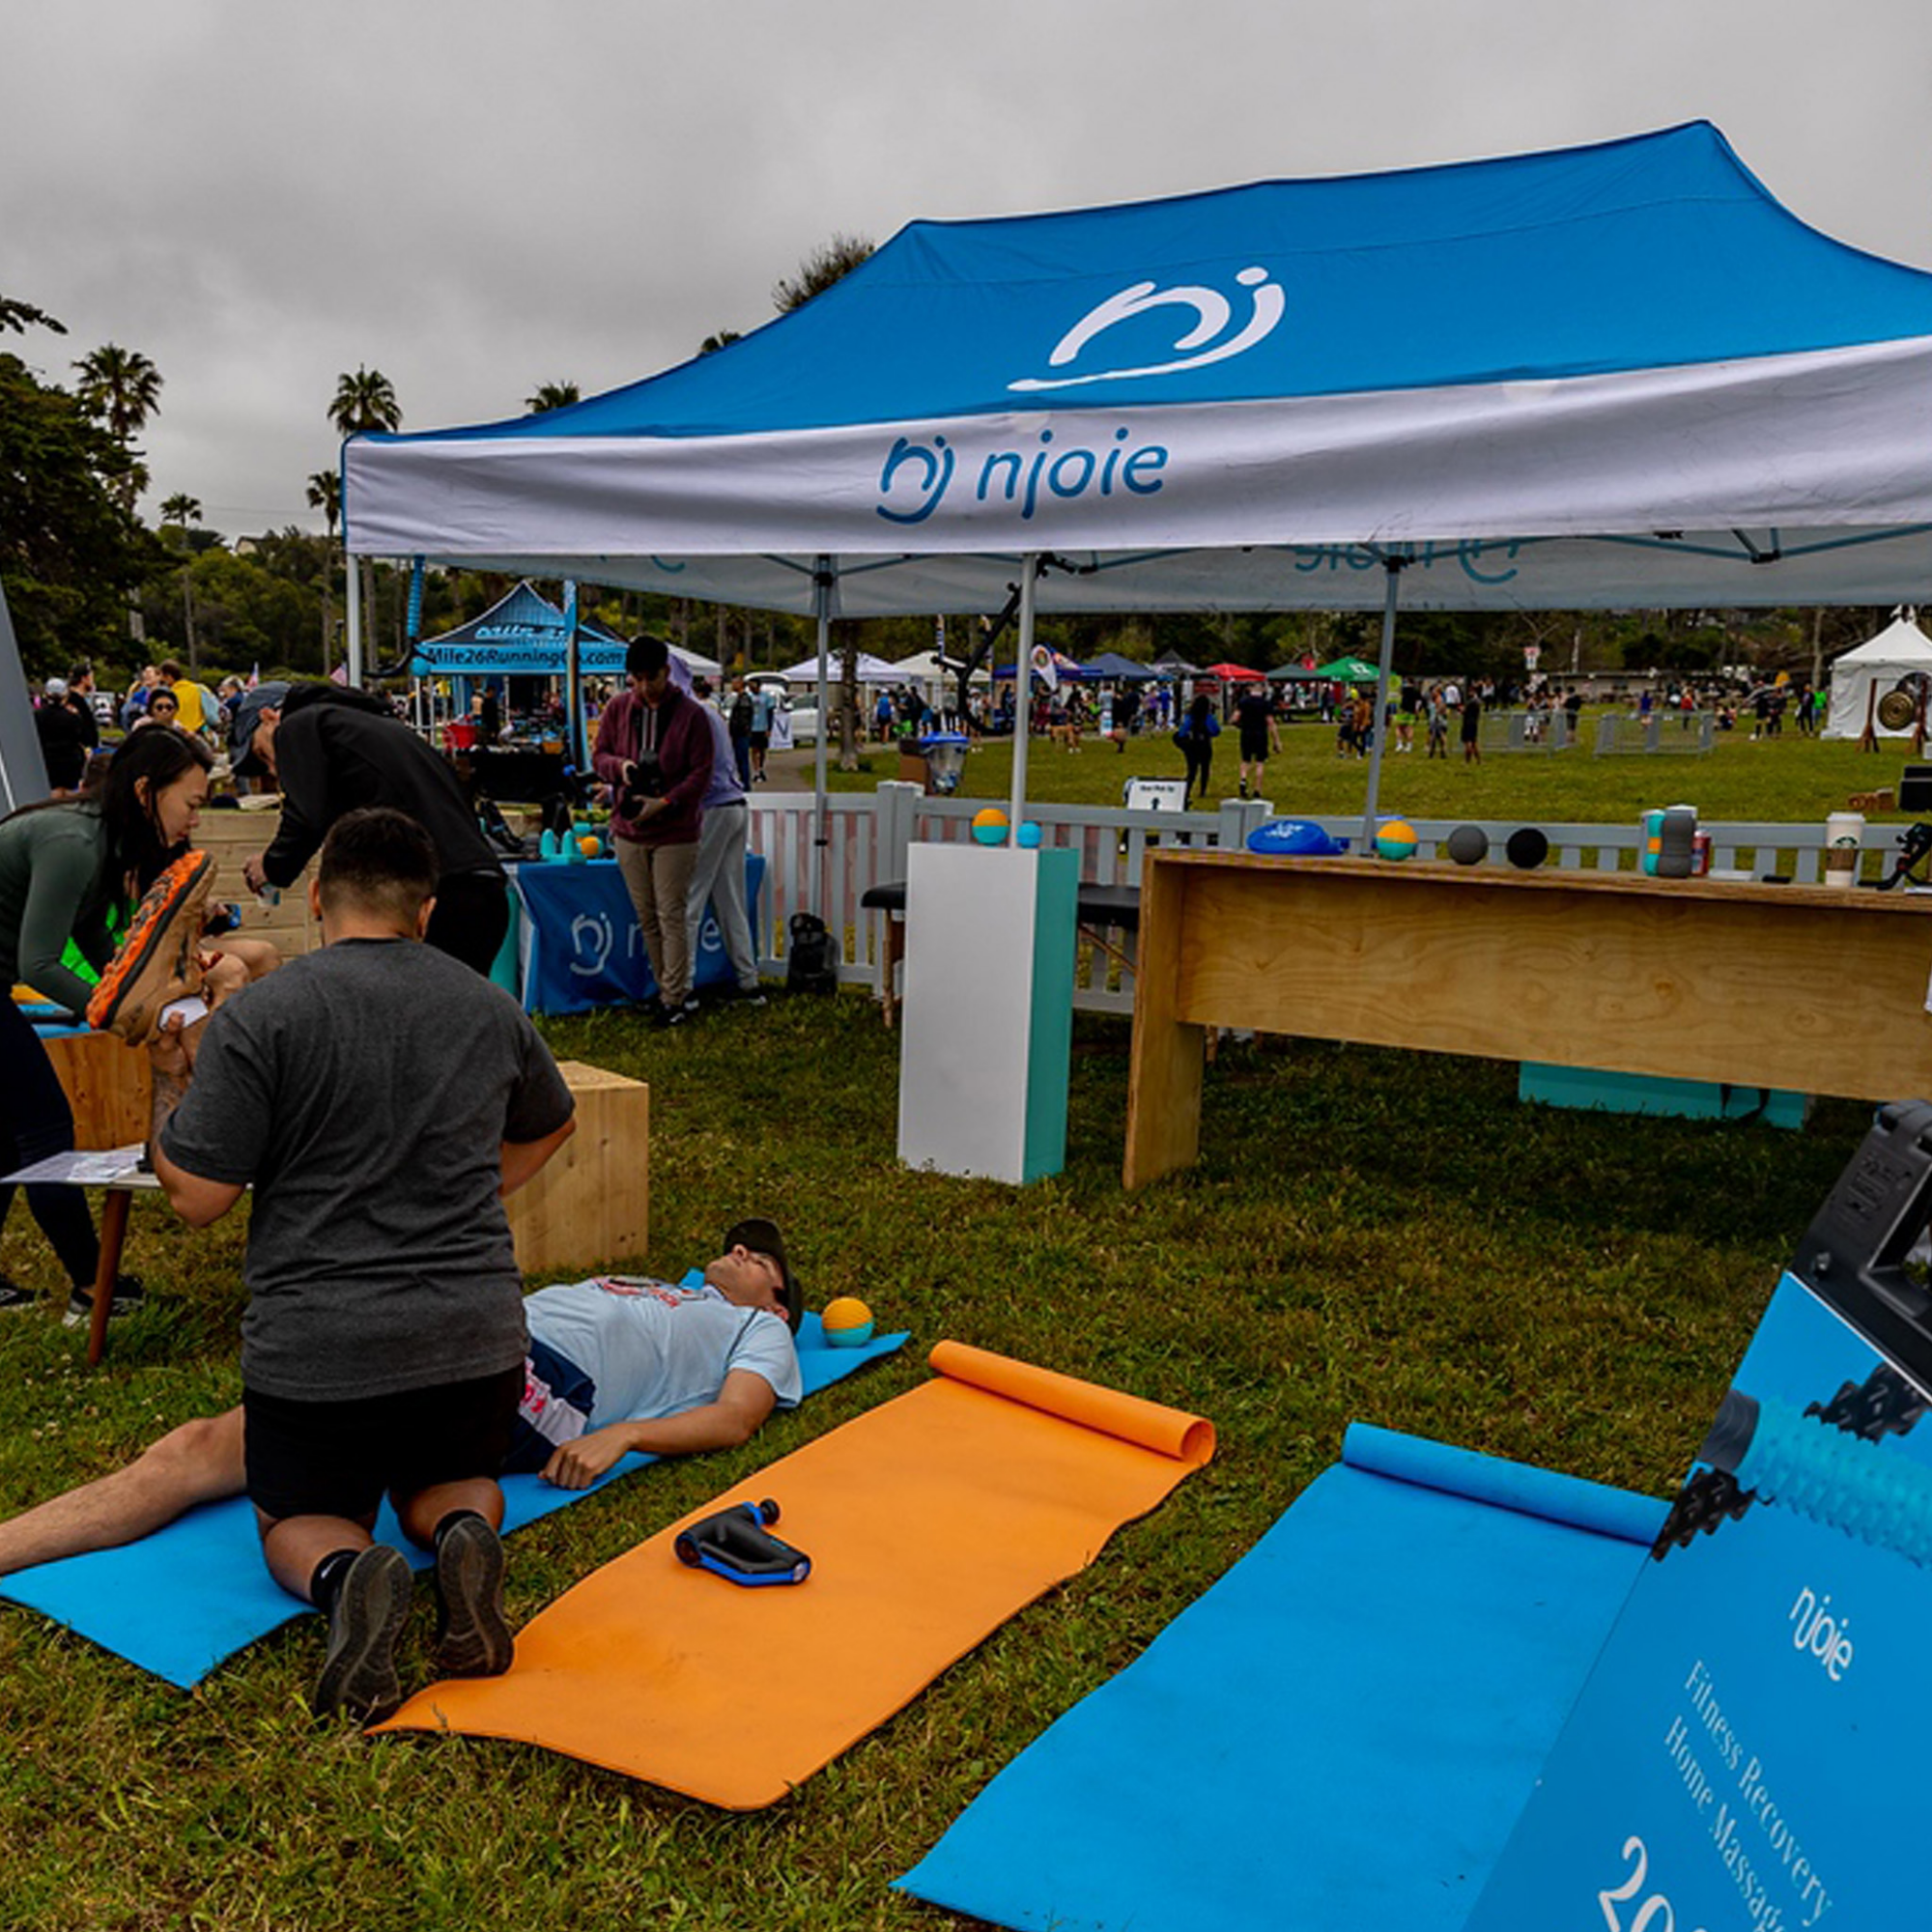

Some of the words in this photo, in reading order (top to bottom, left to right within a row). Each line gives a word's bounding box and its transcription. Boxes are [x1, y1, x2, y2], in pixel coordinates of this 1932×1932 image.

[977, 427, 1170, 520] njoie
[427, 647, 625, 668] Mile26RunningC.com
[1789, 1586, 1854, 1682] njoie
[1664, 1715, 1714, 1814] Home
[1708, 1803, 1788, 1932] Massag
[1685, 1660, 1743, 1771] Fitness
[1739, 1756, 1833, 1927] Recovery
